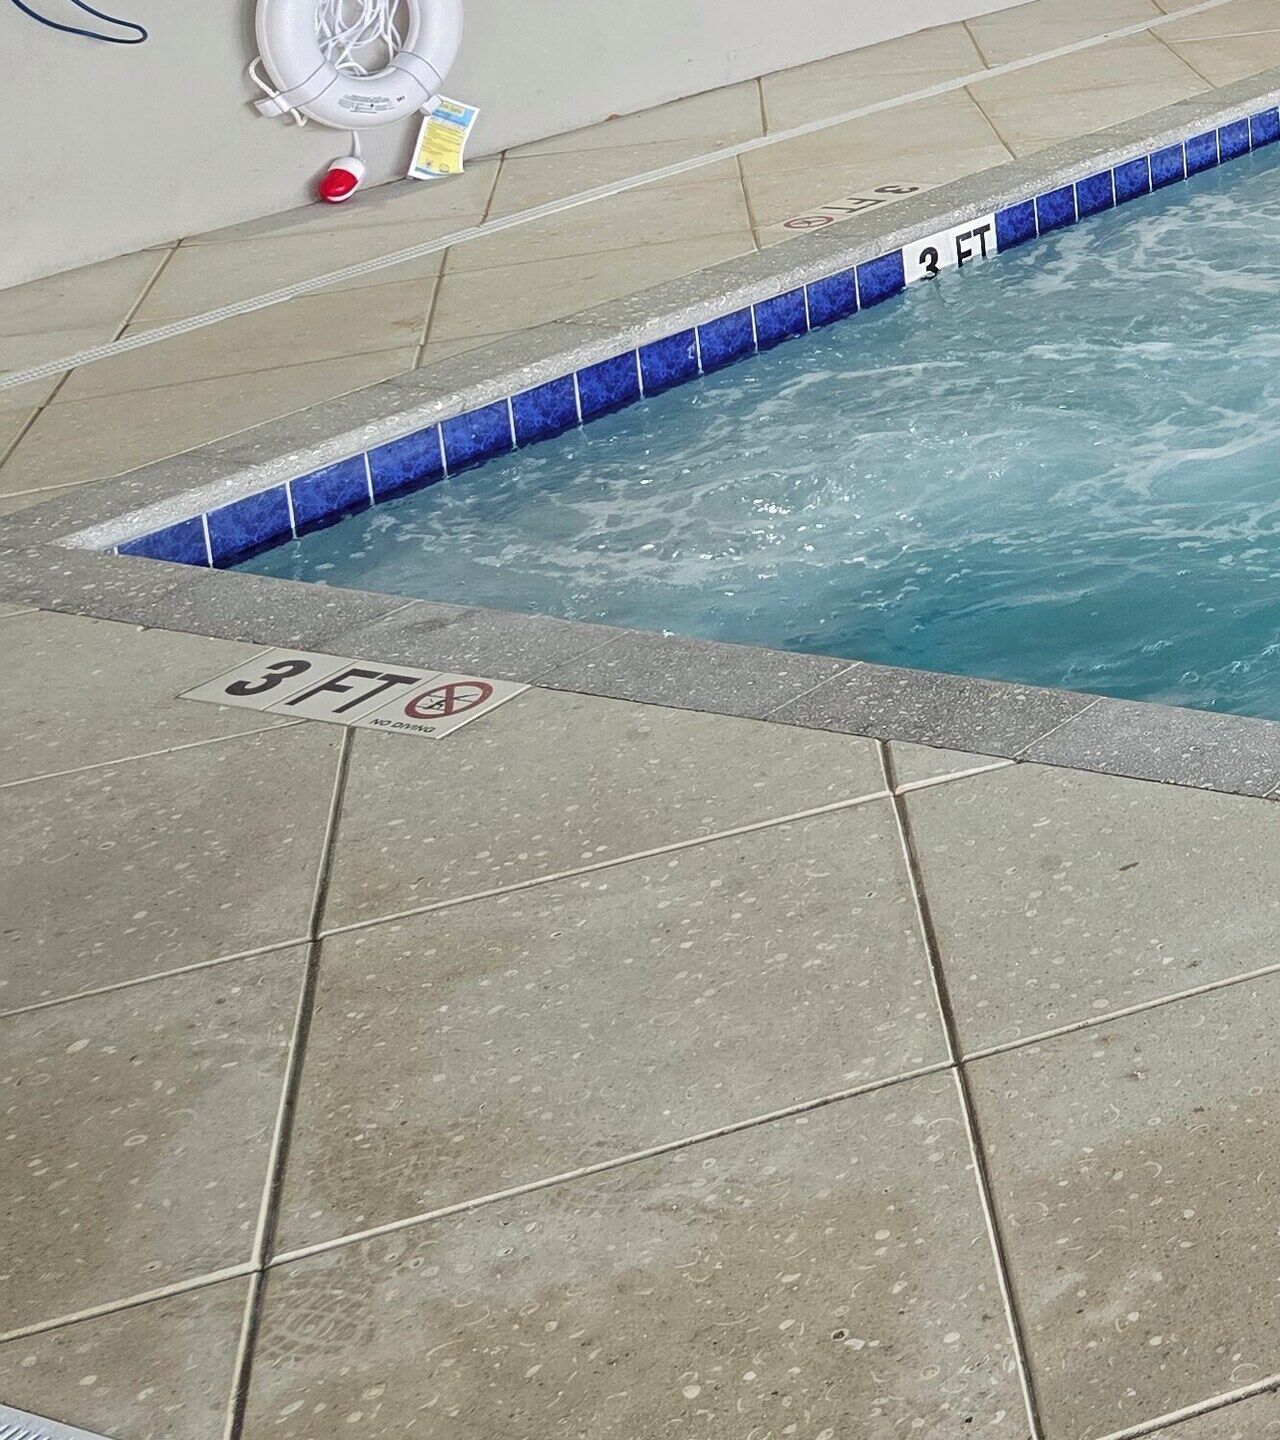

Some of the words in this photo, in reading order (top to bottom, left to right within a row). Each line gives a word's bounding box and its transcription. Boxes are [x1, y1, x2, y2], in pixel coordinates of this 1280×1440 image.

[874, 184, 920, 195] 3
[823, 197, 886, 214] FT
[918, 246, 940, 280] 3
[955, 223, 991, 268] FT
[224, 659, 312, 697] 3
[285, 668, 421, 714] FT
[369, 718, 392, 726] NO
[391, 721, 437, 733] DIVING
